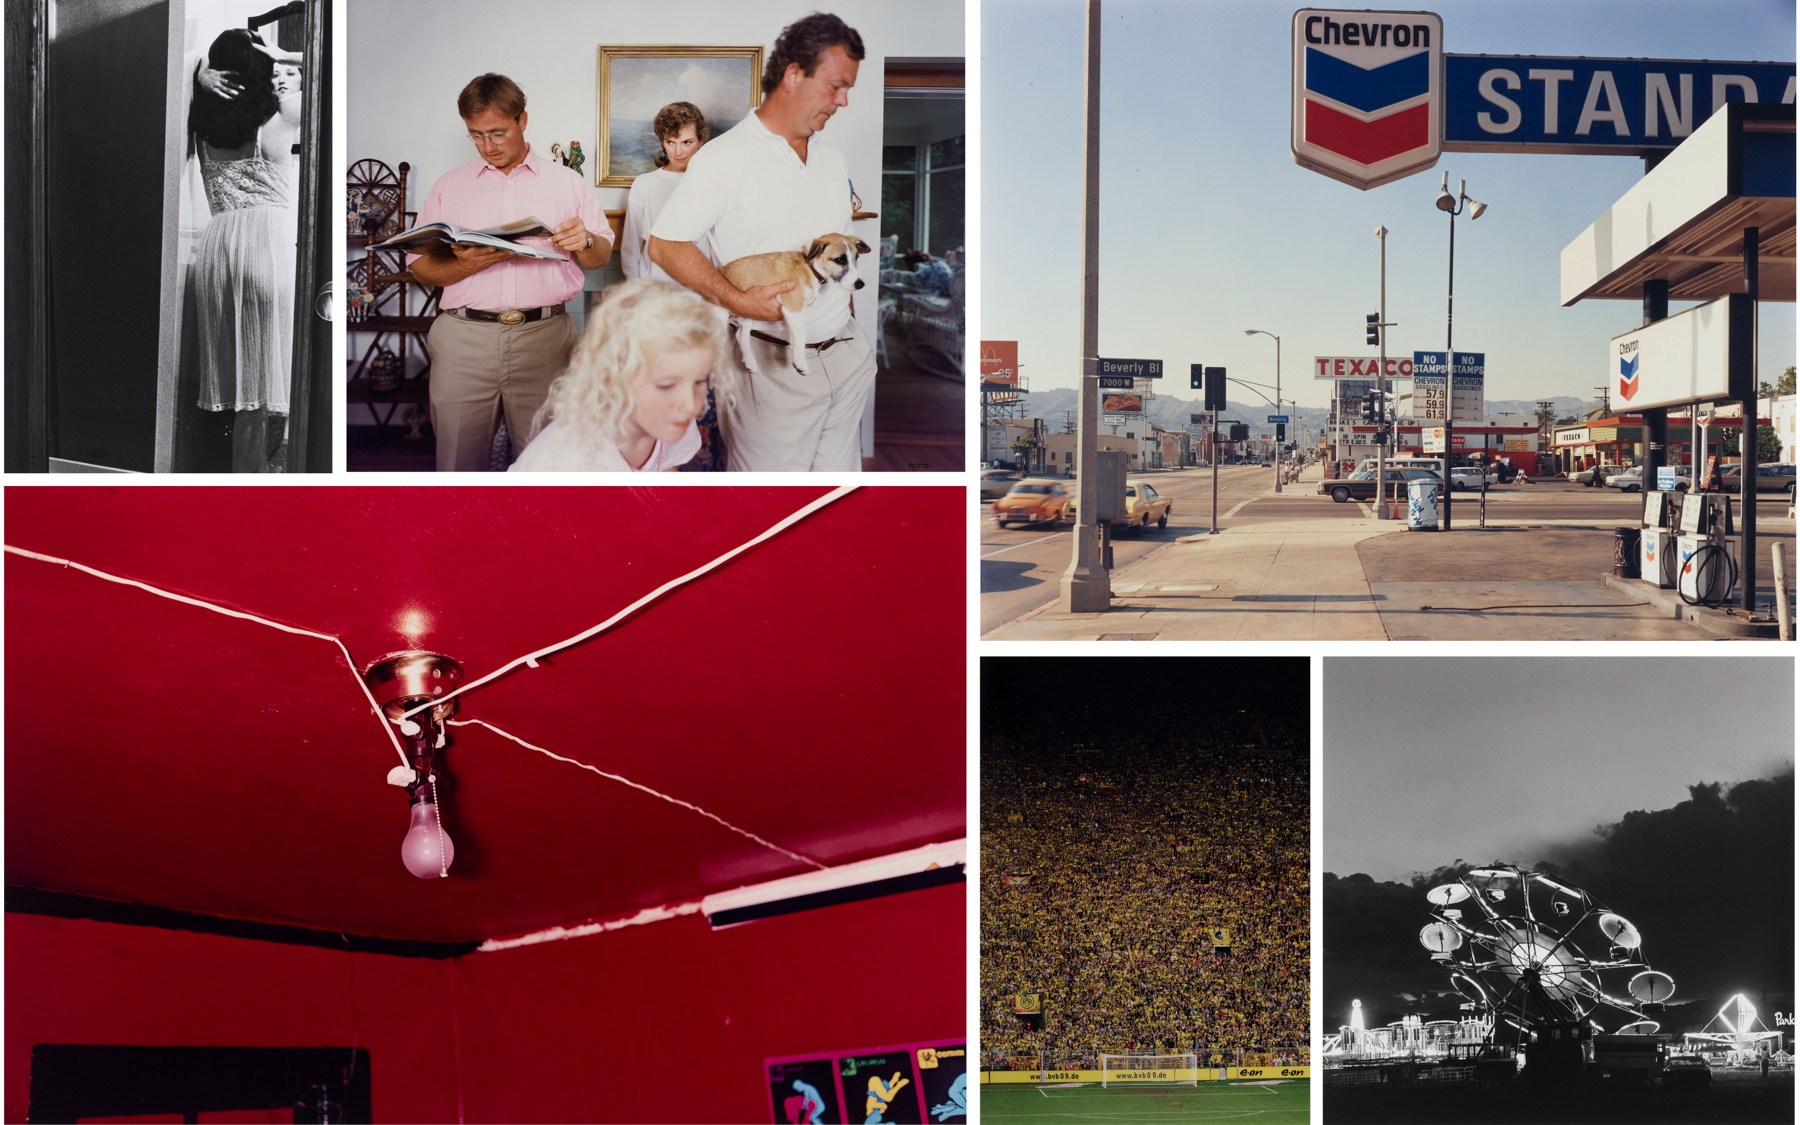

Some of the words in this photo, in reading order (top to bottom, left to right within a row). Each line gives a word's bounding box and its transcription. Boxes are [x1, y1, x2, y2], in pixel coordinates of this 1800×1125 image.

[1305, 15, 1430, 47] Chevron
[1620, 340, 1639, 355] Chevron
[1423, 355, 1437, 364] NO
[1461, 356, 1475, 365] NO
[1103, 361, 1144, 375] Beverly
[1149, 362, 1160, 374] Bl
[1316, 358, 1413, 376] TEXACO
[1413, 364, 1447, 374] STAMPS
[1452, 365, 1484, 375] STAMPS
[1103, 378, 1123, 387] 7000
[1124, 379, 1130, 387] W
[1414, 377, 1445, 386] CHEVRON
[1452, 377, 1483, 387] CHEVRON
[1426, 389, 1445, 399] 57.9
[1426, 399, 1445, 409] 59.9
[1425, 409, 1445, 419] 61.9
[1774, 1011, 1795, 1027] Park
[1029, 1072, 1080, 1080] ww.bvb09.de
